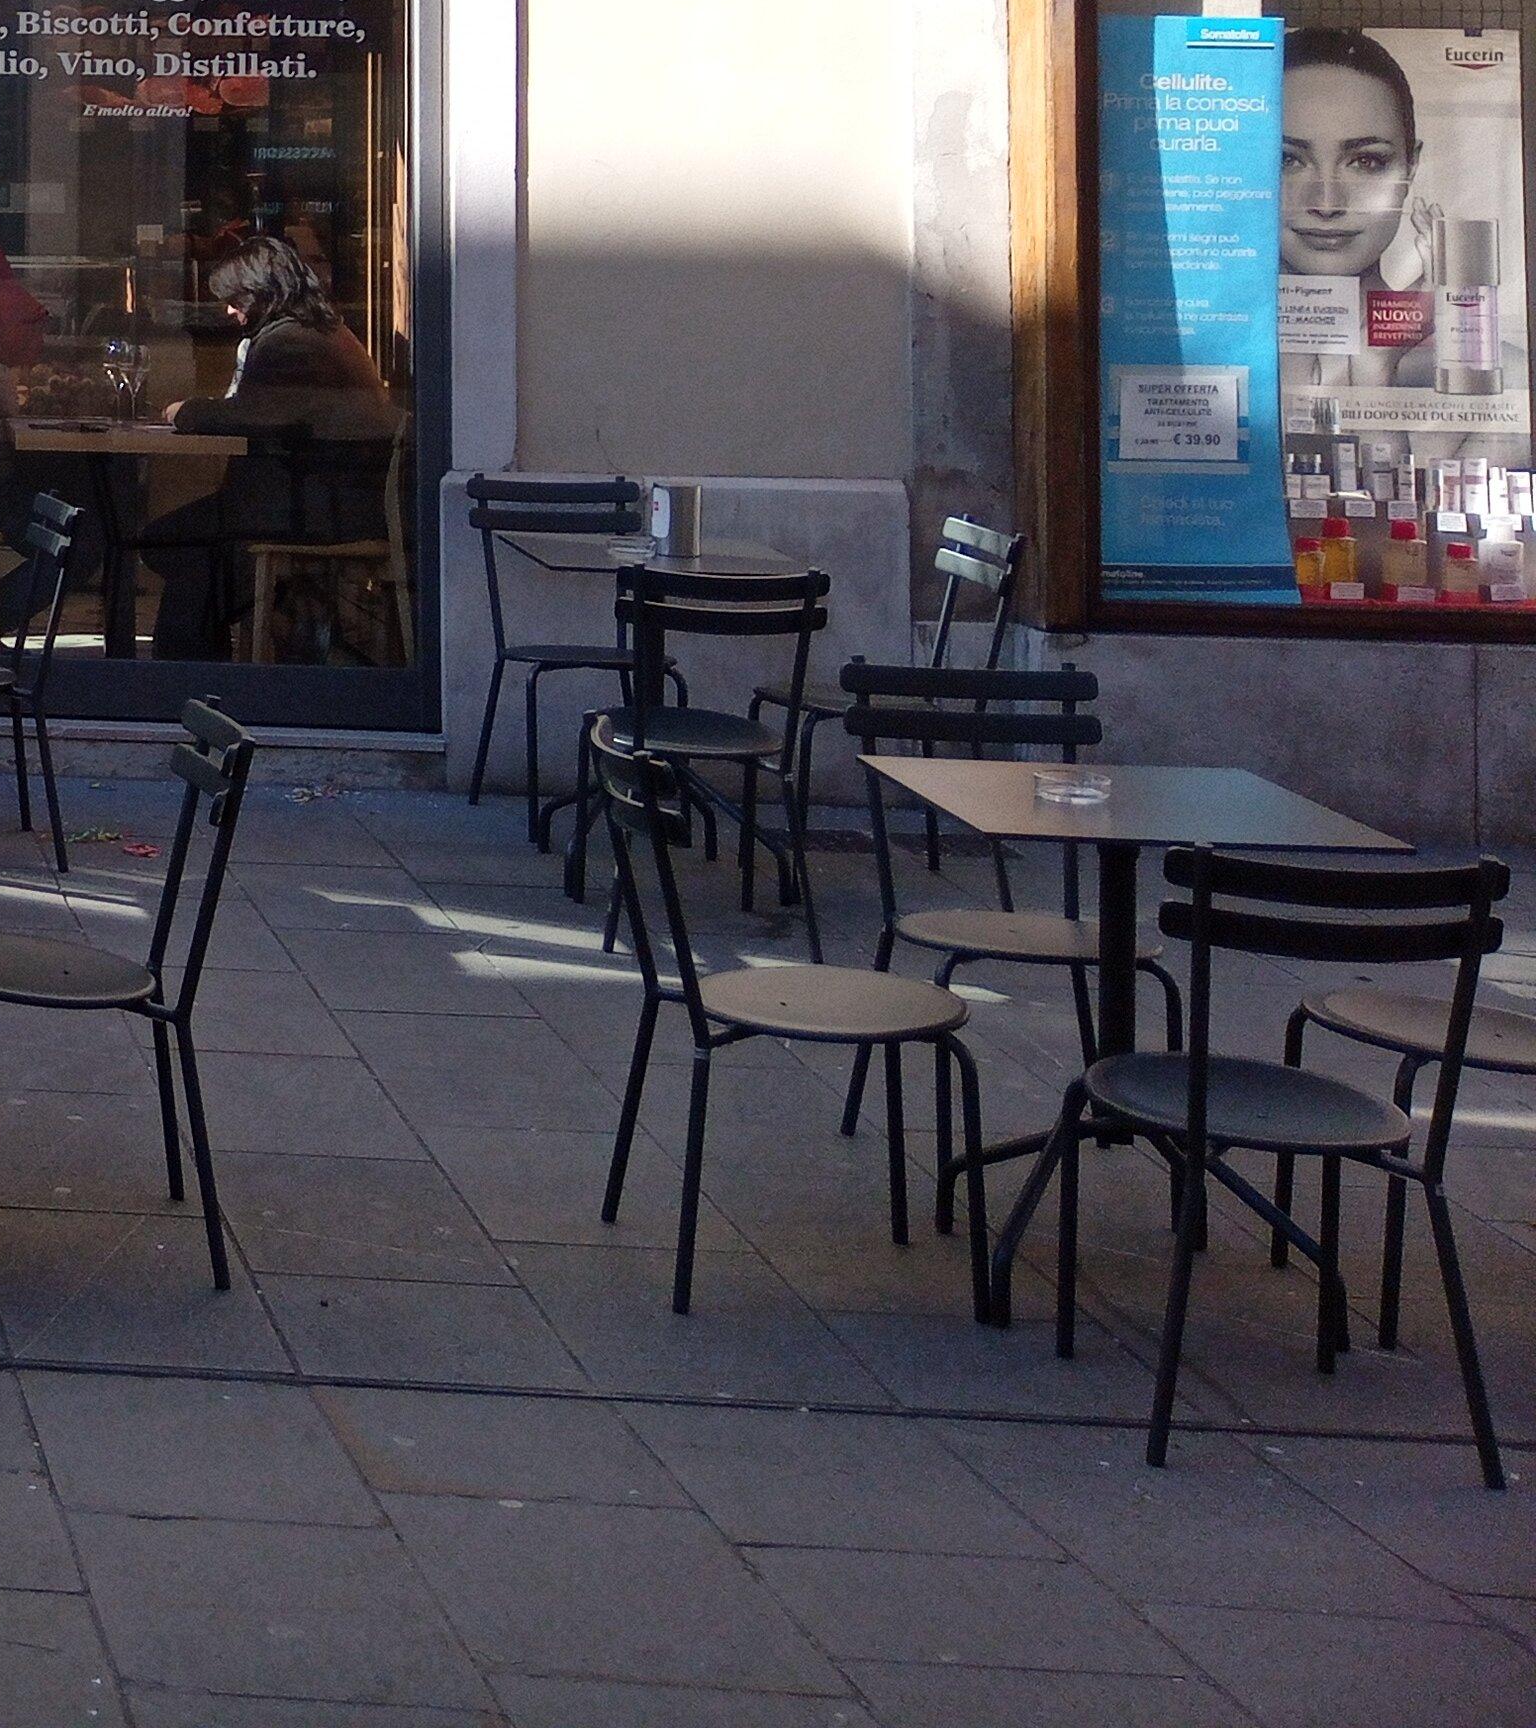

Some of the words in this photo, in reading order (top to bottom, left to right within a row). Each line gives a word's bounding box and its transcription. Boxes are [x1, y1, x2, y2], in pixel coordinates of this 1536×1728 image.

[15, 9, 160, 41] Biscotti,
[167, 10, 366, 42] Confetture,
[1445, 46, 1504, 62] Eucerin
[56, 50, 146, 81] Vino,
[152, 50, 318, 80] Distillati.
[1139, 73, 1233, 91] Cellulite.
[82, 104, 97, 117] E
[98, 103, 143, 118] molto
[146, 103, 193, 119] altro!
[1165, 94, 1182, 111] la
[1185, 94, 1269, 113] conosci,
[1195, 115, 1239, 133] puoi
[1149, 134, 1221, 152] curarla.
[1372, 309, 1424, 322] NUOVO
[1173, 384, 1219, 394] OFFERTA
[1363, 410, 1399, 421] DOPO
[1401, 409, 1427, 421] SOLE
[1430, 410, 1454, 422] DUE
[1185, 433, 1221, 446] 39.90
